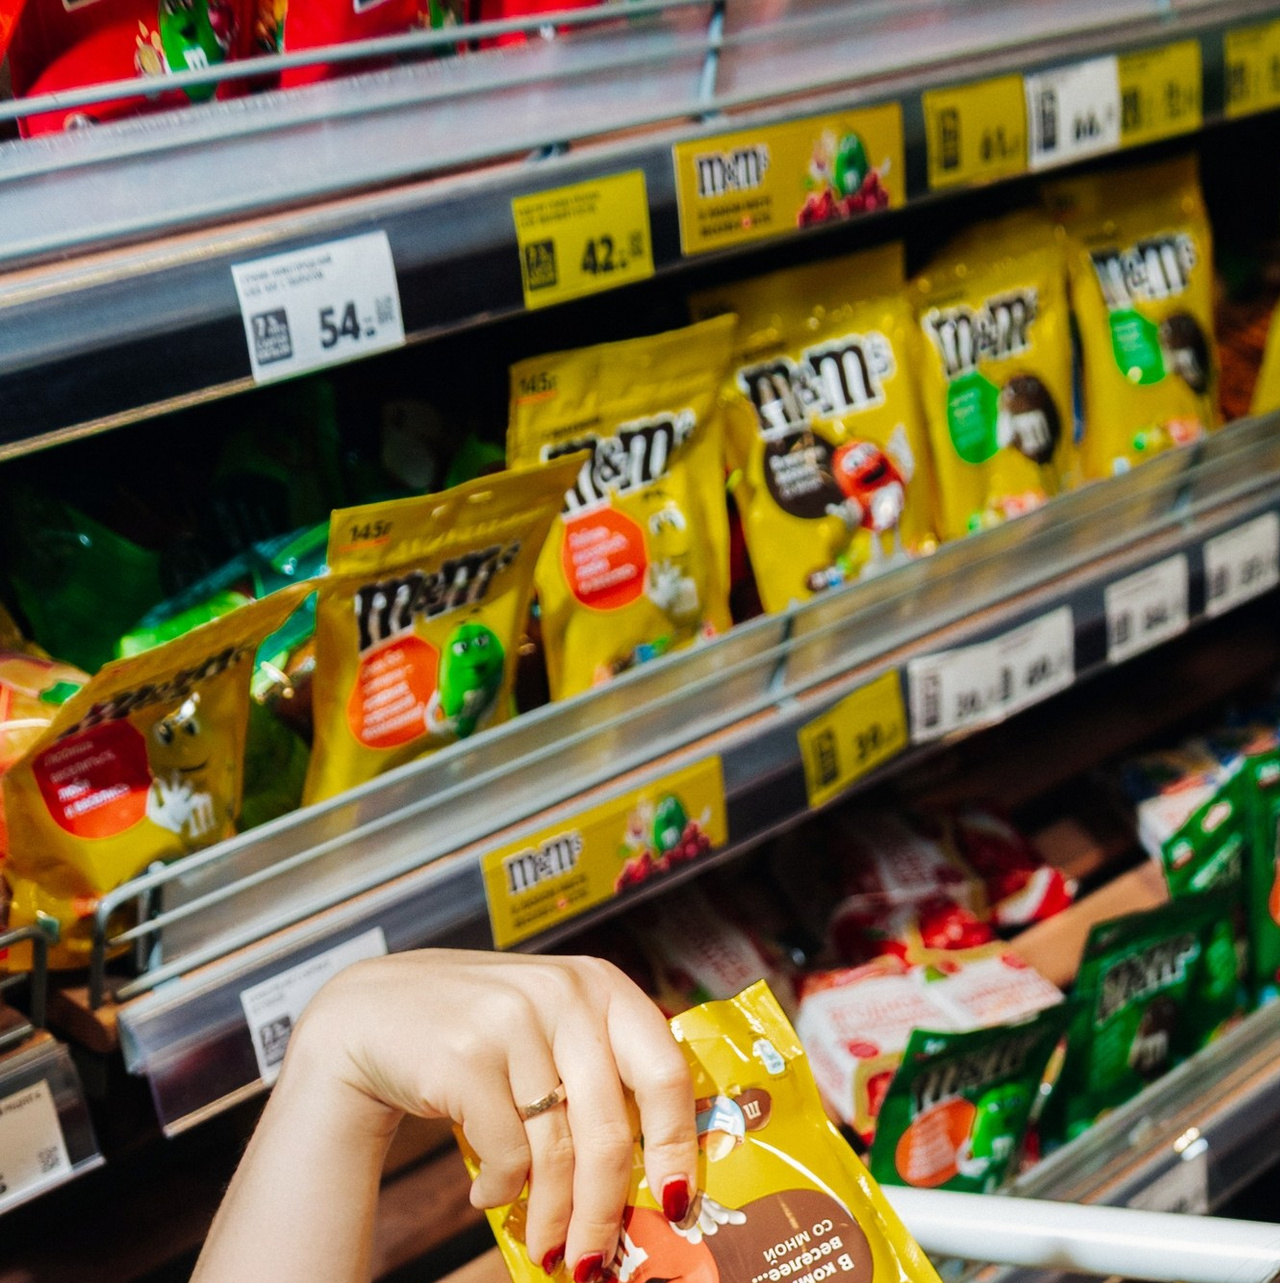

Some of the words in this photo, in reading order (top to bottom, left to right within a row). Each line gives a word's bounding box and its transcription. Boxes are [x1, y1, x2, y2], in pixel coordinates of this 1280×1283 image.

[319, 300, 360, 350] 54
[812, 1219, 833, 1237] со
[751, 1236, 843, 1283] веселее...
[763, 1230, 811, 1266] мной
[837, 1253, 855, 1271] В
